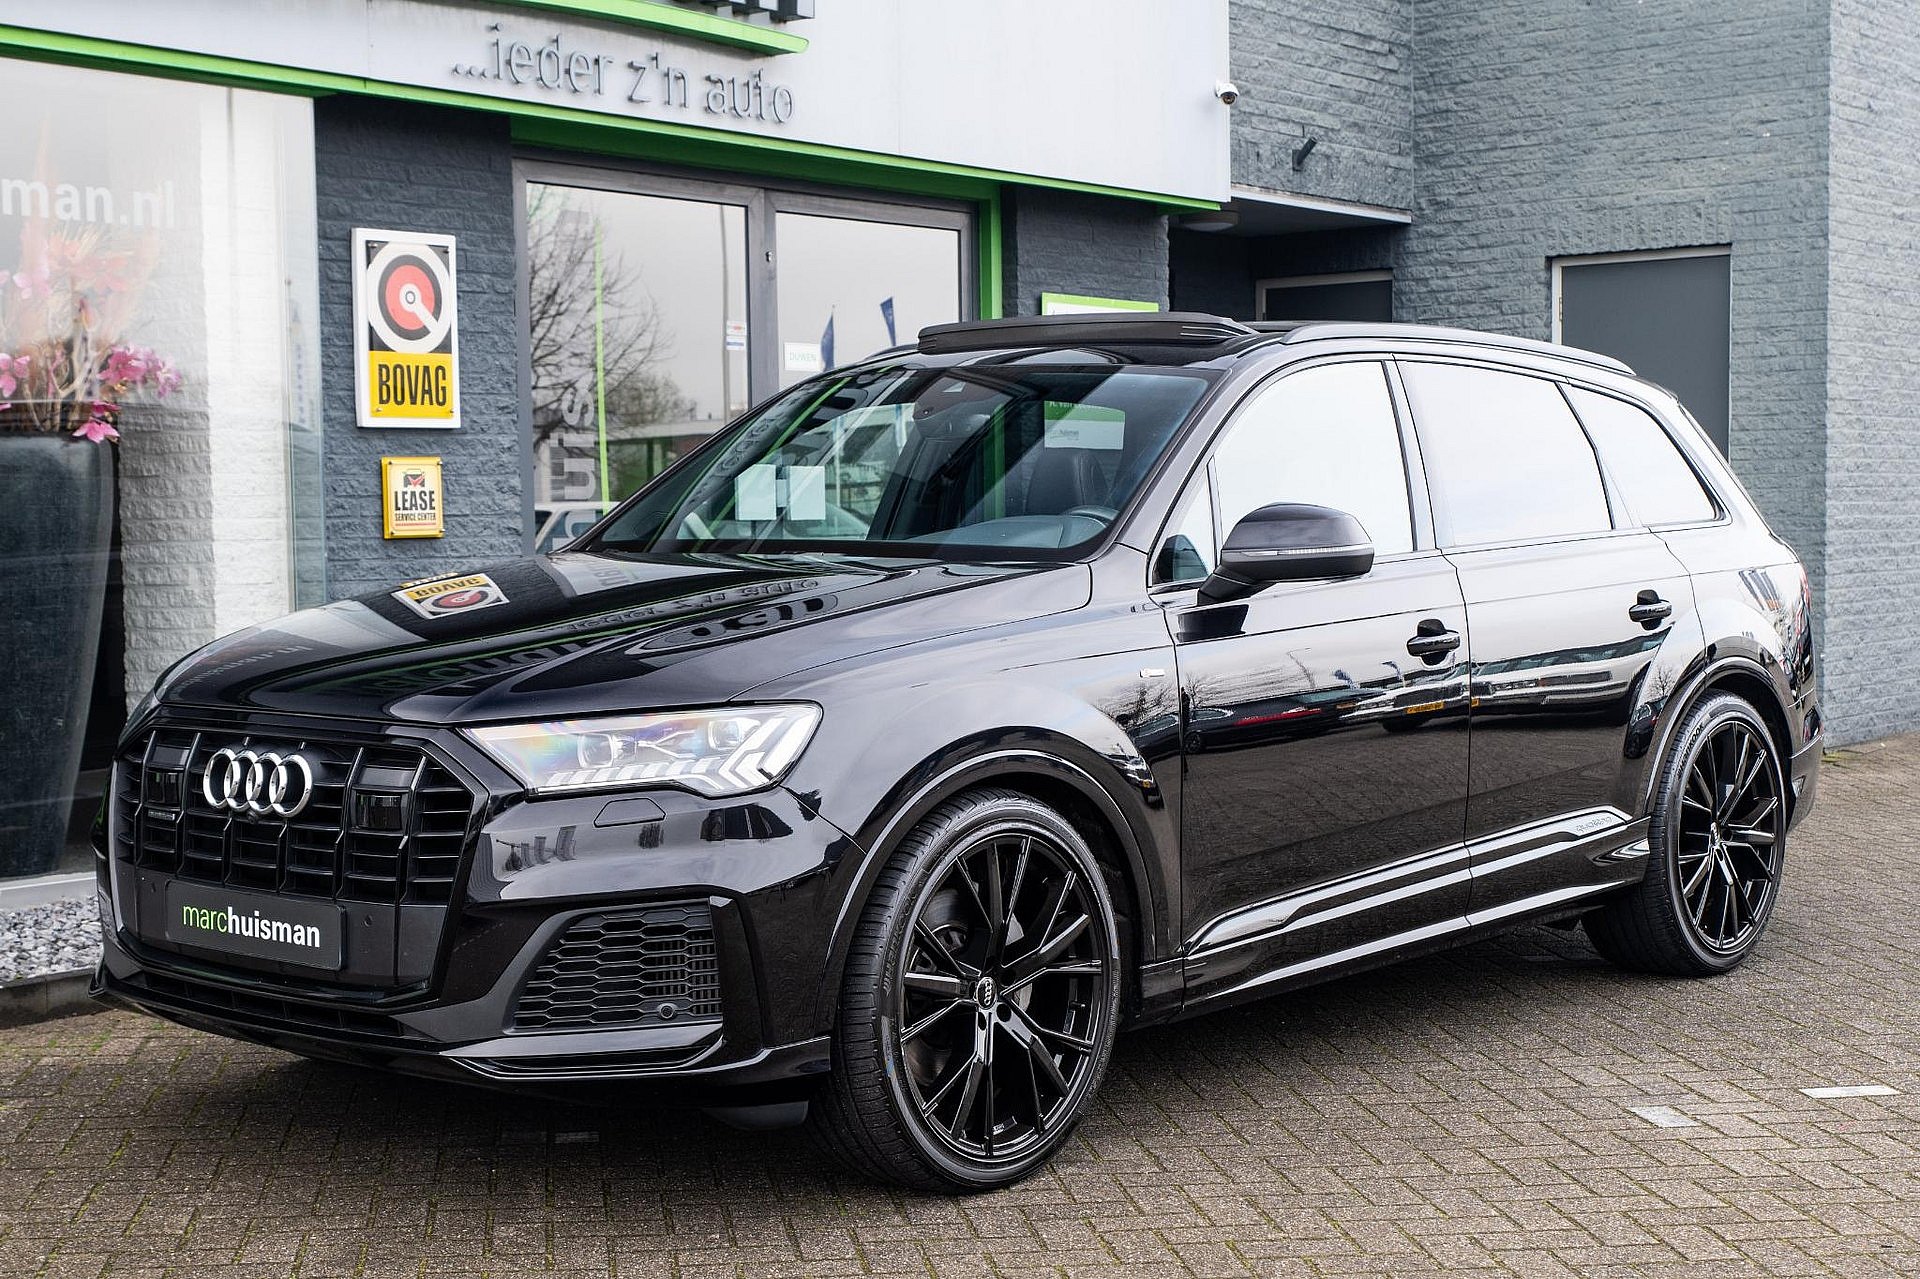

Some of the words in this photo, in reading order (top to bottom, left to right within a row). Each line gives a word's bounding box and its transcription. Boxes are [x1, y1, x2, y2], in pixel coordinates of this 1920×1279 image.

[627, 52, 690, 109] z'n
[704, 68, 795, 124] auto
[1, 178, 176, 230] man.nl
[378, 363, 447, 407] BOVAG
[394, 490, 436, 511] LEASE
[394, 512, 416, 522] SERVICE
[417, 512, 437, 521] CENTER
[183, 905, 320, 948] marchuisman
